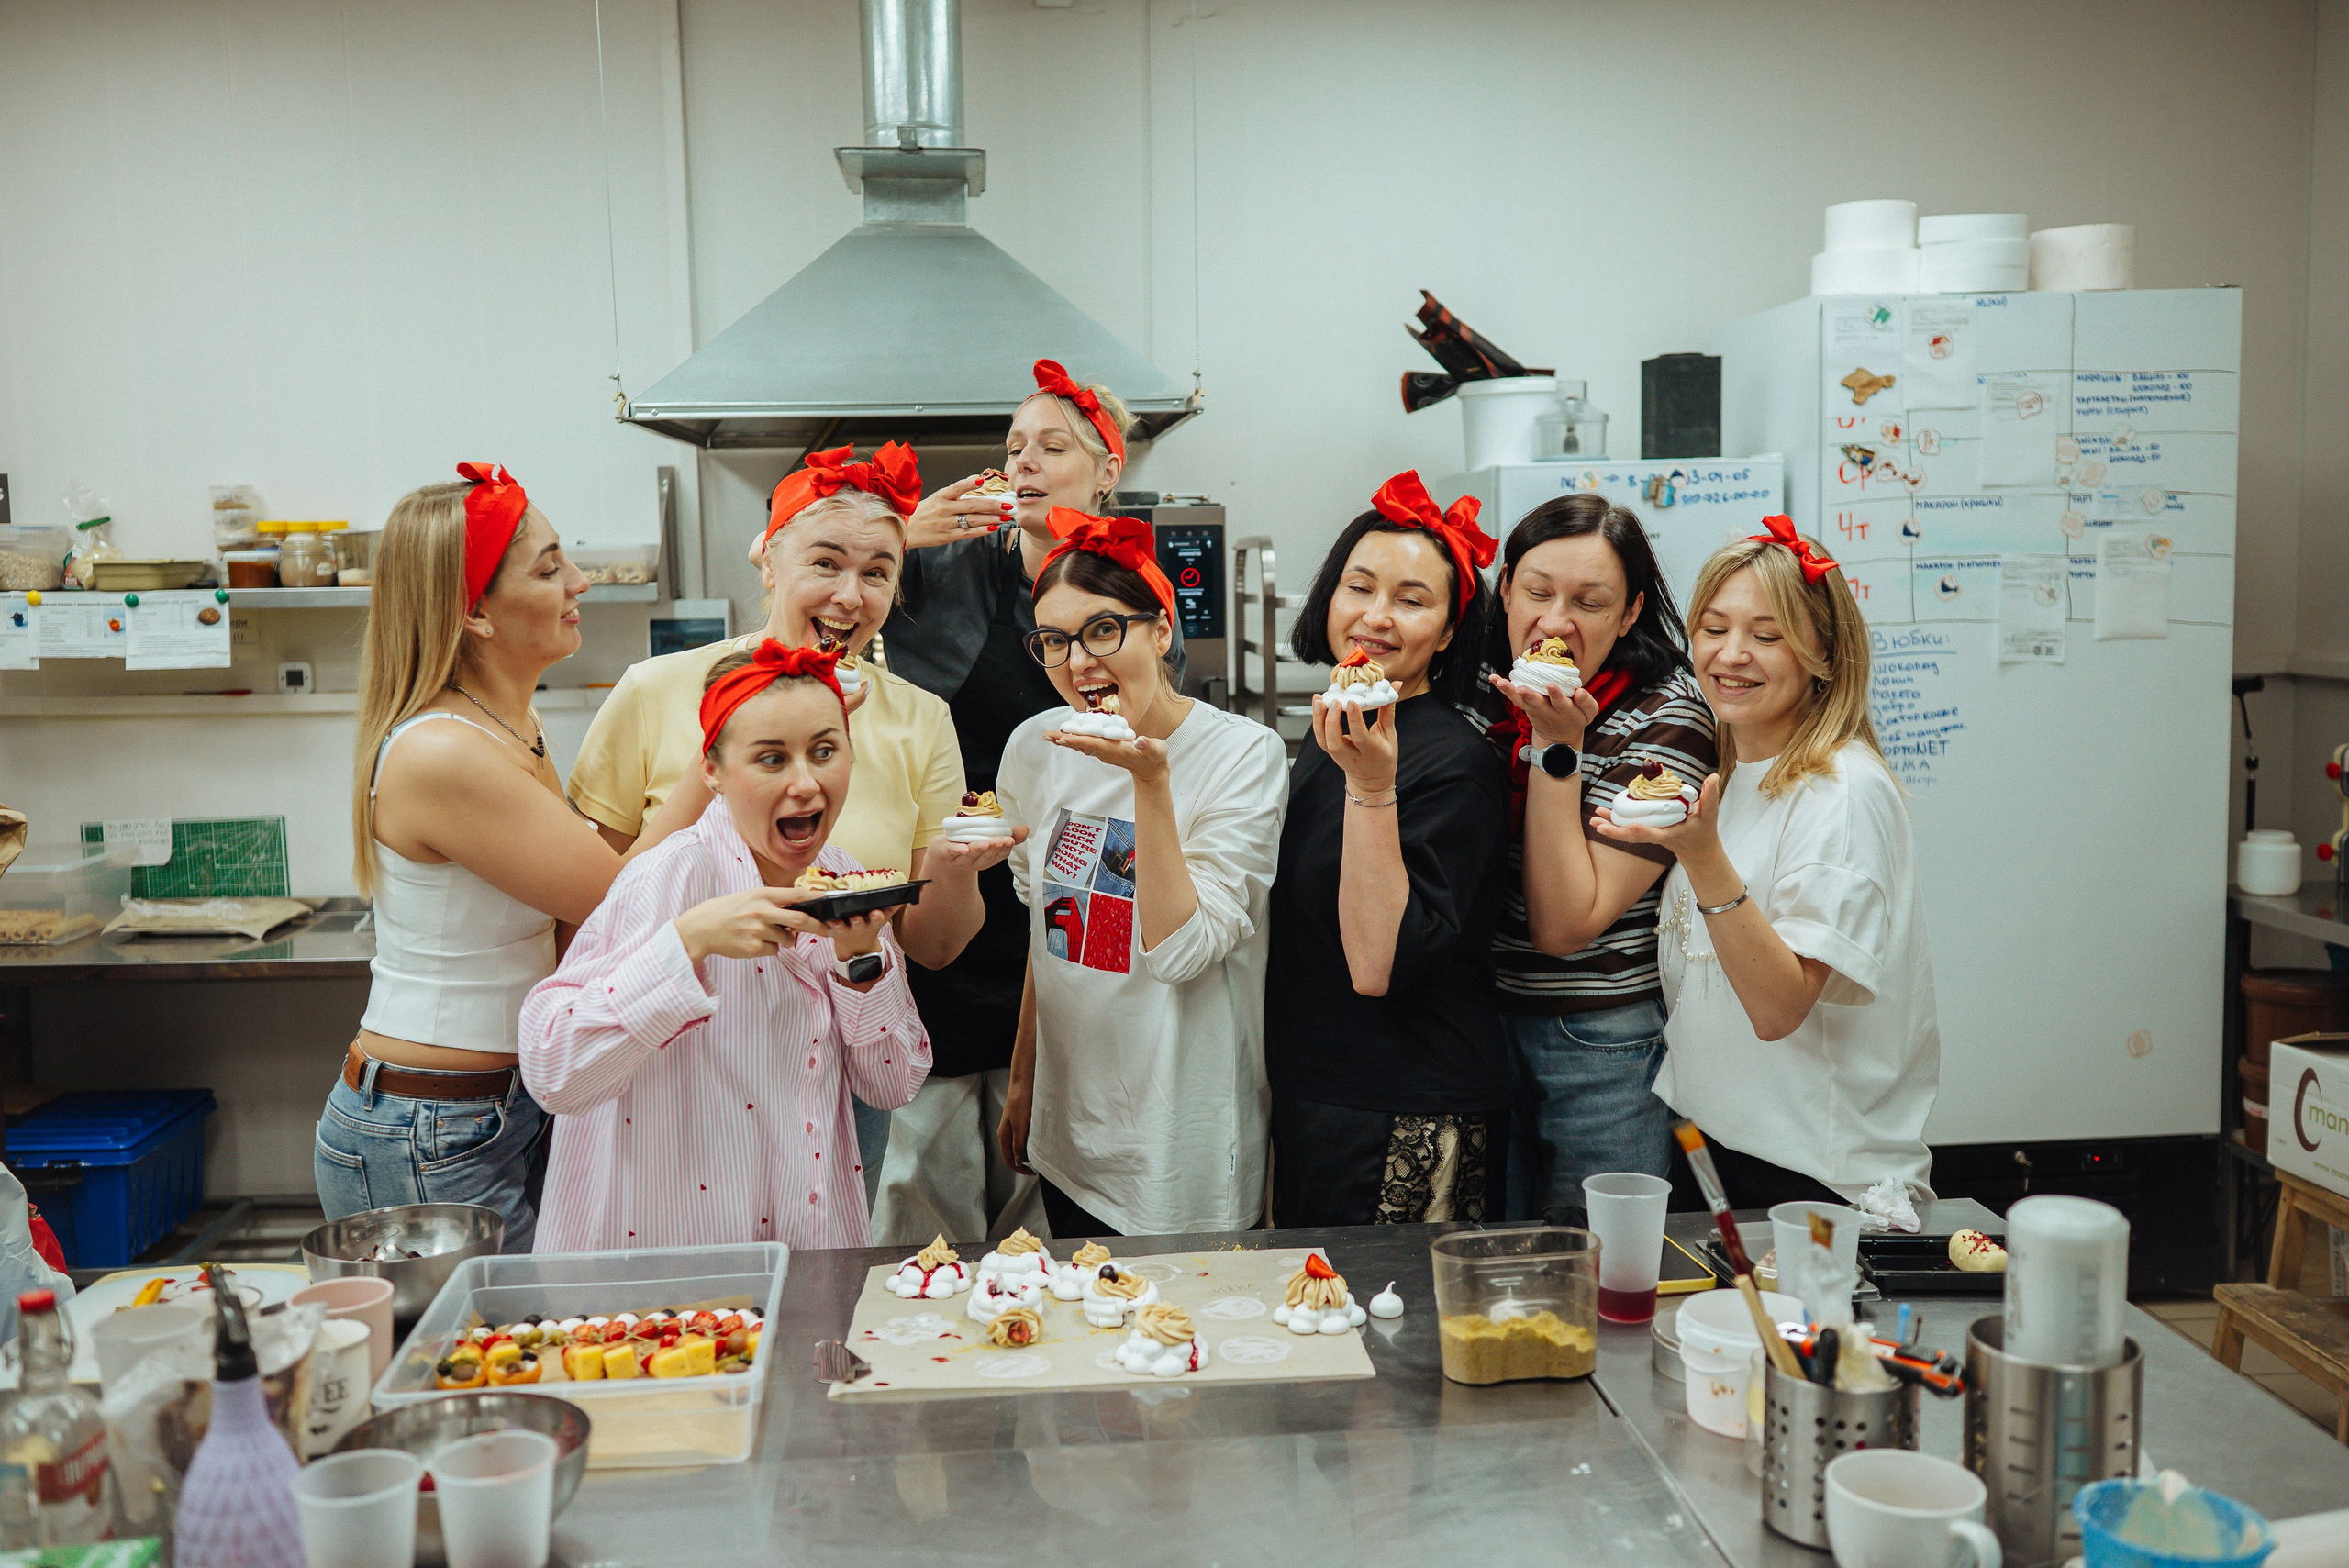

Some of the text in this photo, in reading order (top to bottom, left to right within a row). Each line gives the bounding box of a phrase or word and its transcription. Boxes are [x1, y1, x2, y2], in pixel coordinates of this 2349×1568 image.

[1066, 827, 1097, 839] LOOK
[1068, 822, 1102, 833] DON'T
[1060, 837, 1097, 854] YOU'RE
[1063, 831, 1095, 845] BACK
[1061, 842, 1085, 856] NOT
[1055, 847, 1087, 867] GOING
[1055, 853, 1081, 871] THAT
[1052, 860, 1077, 879] WAY!
